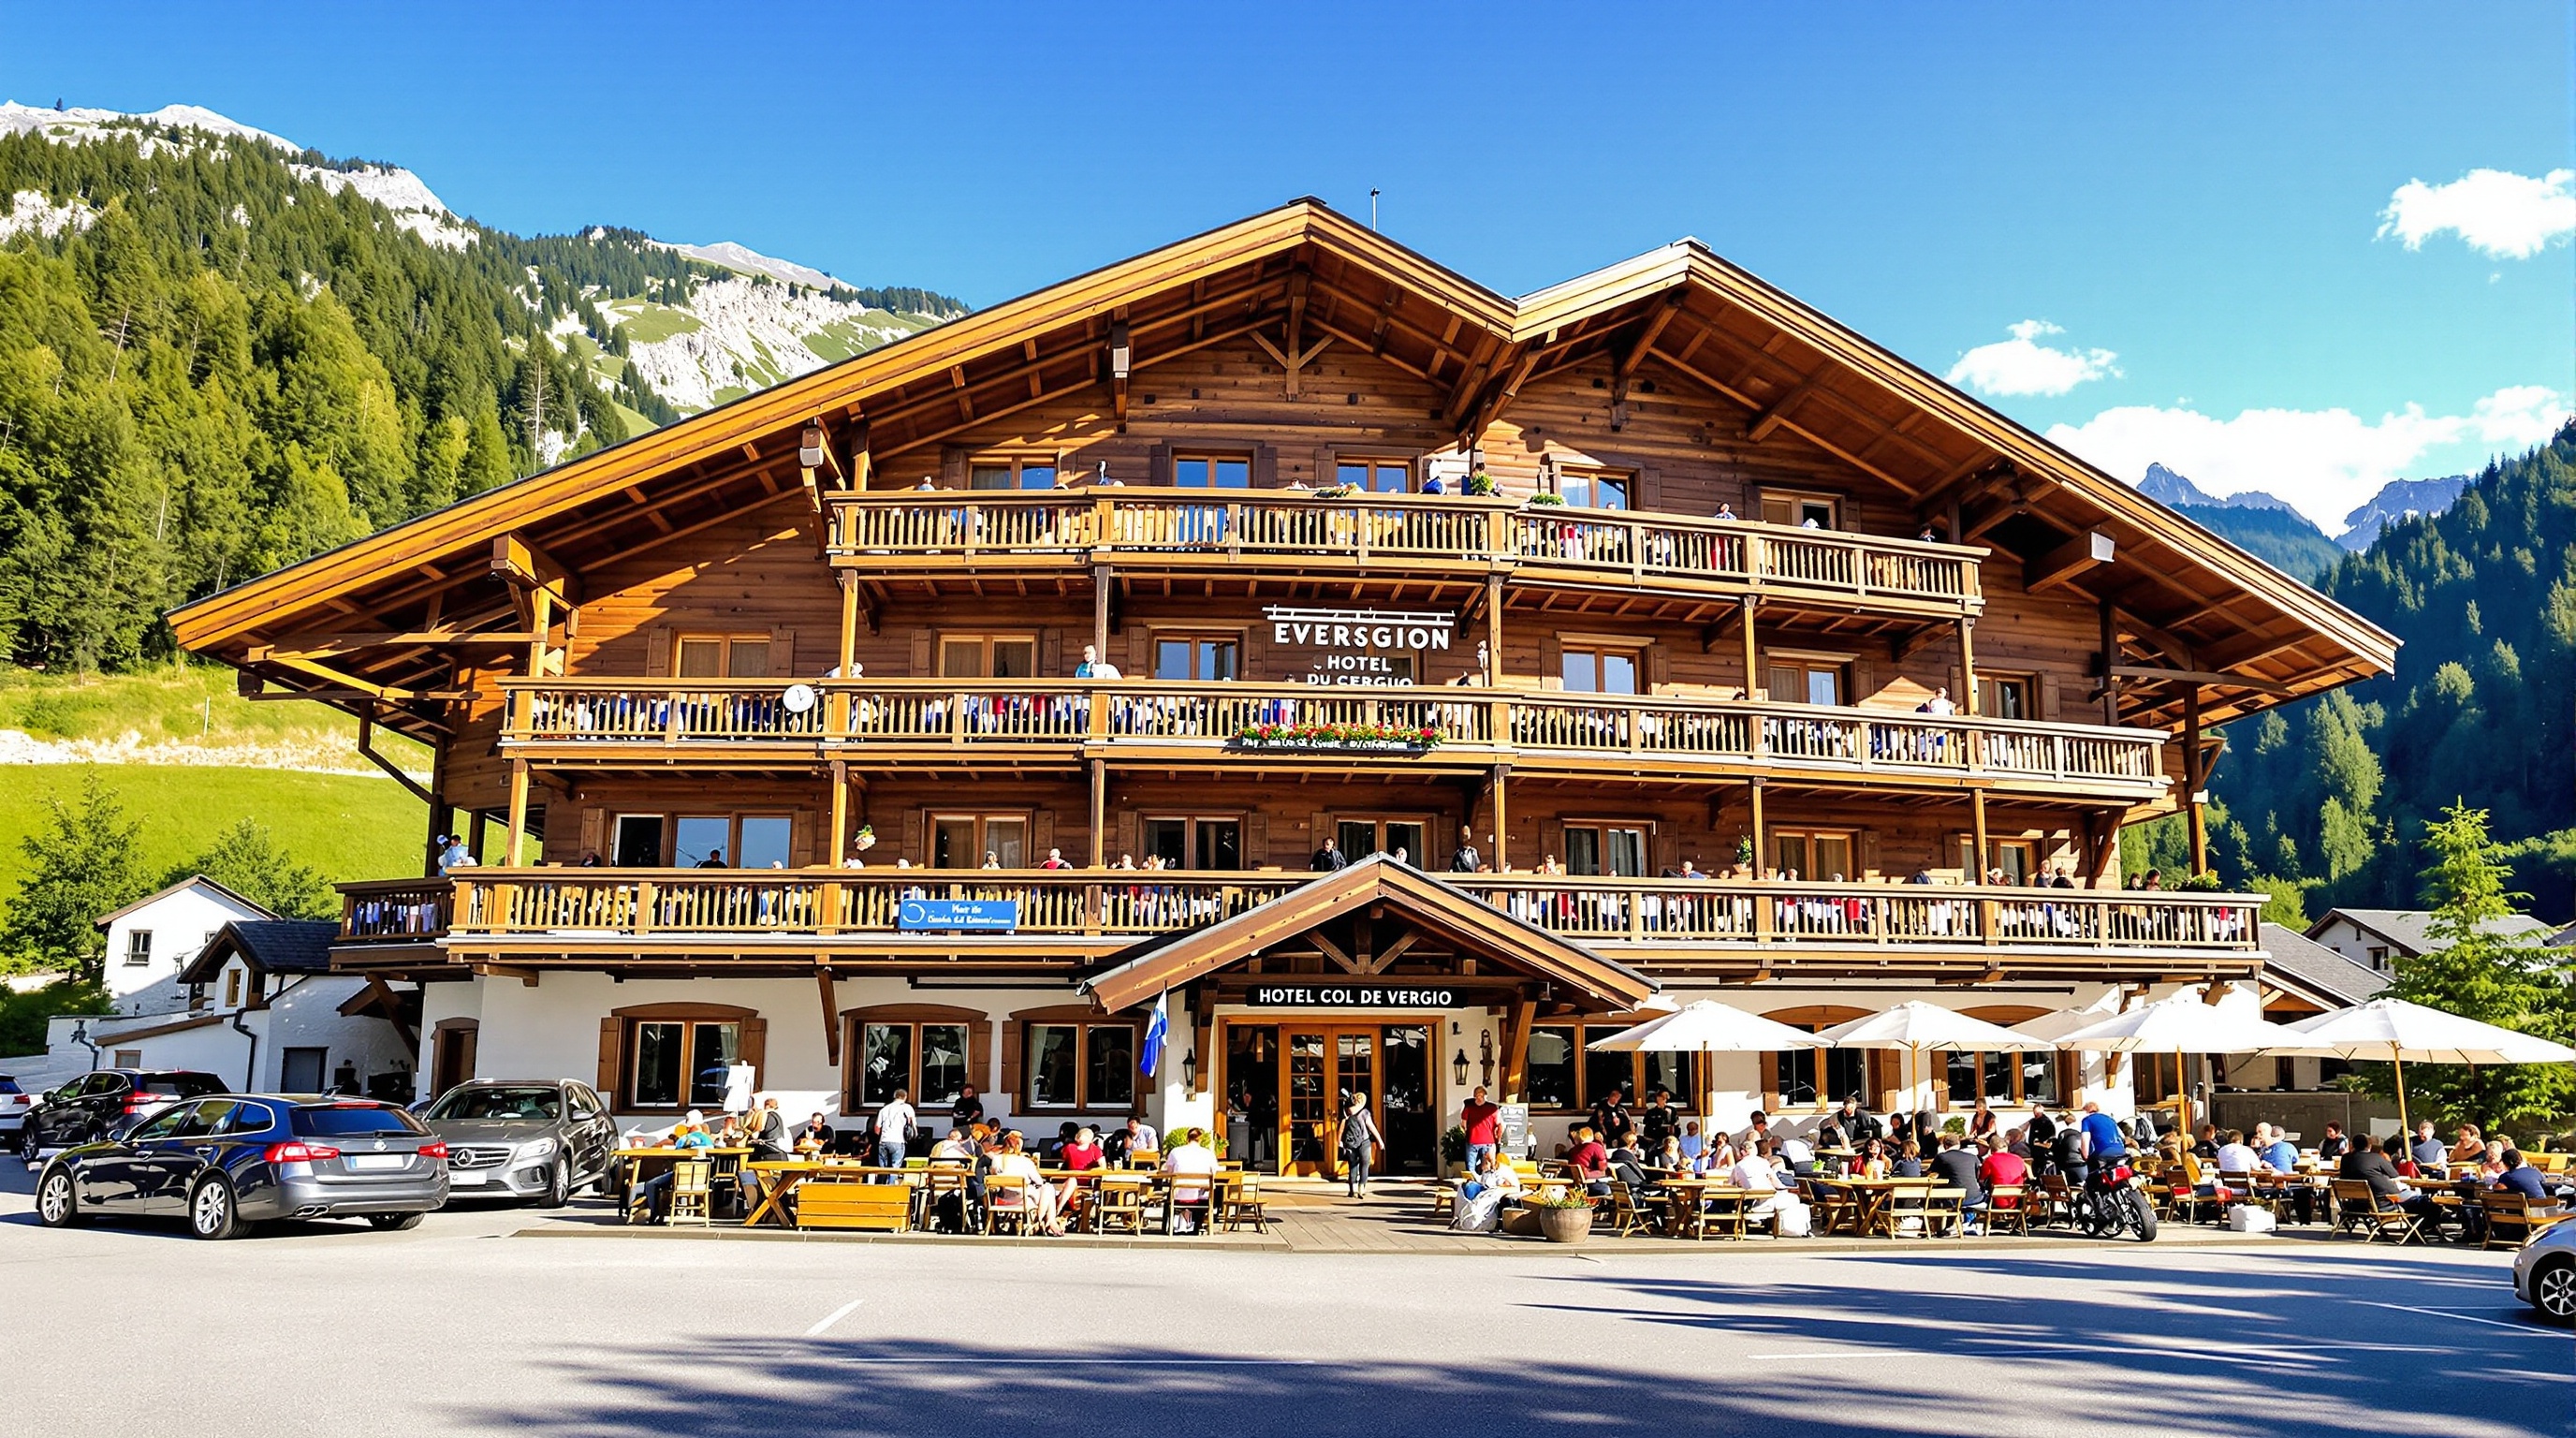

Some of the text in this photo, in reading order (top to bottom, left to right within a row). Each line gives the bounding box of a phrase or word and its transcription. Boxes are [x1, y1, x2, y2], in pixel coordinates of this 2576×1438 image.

[1274, 623, 1450, 650] EVERSGION
[1327, 654, 1393, 672] HOTEL
[1307, 673, 1331, 685] DU
[1259, 988, 1452, 1005] HOTEL COL DE VERGIO
